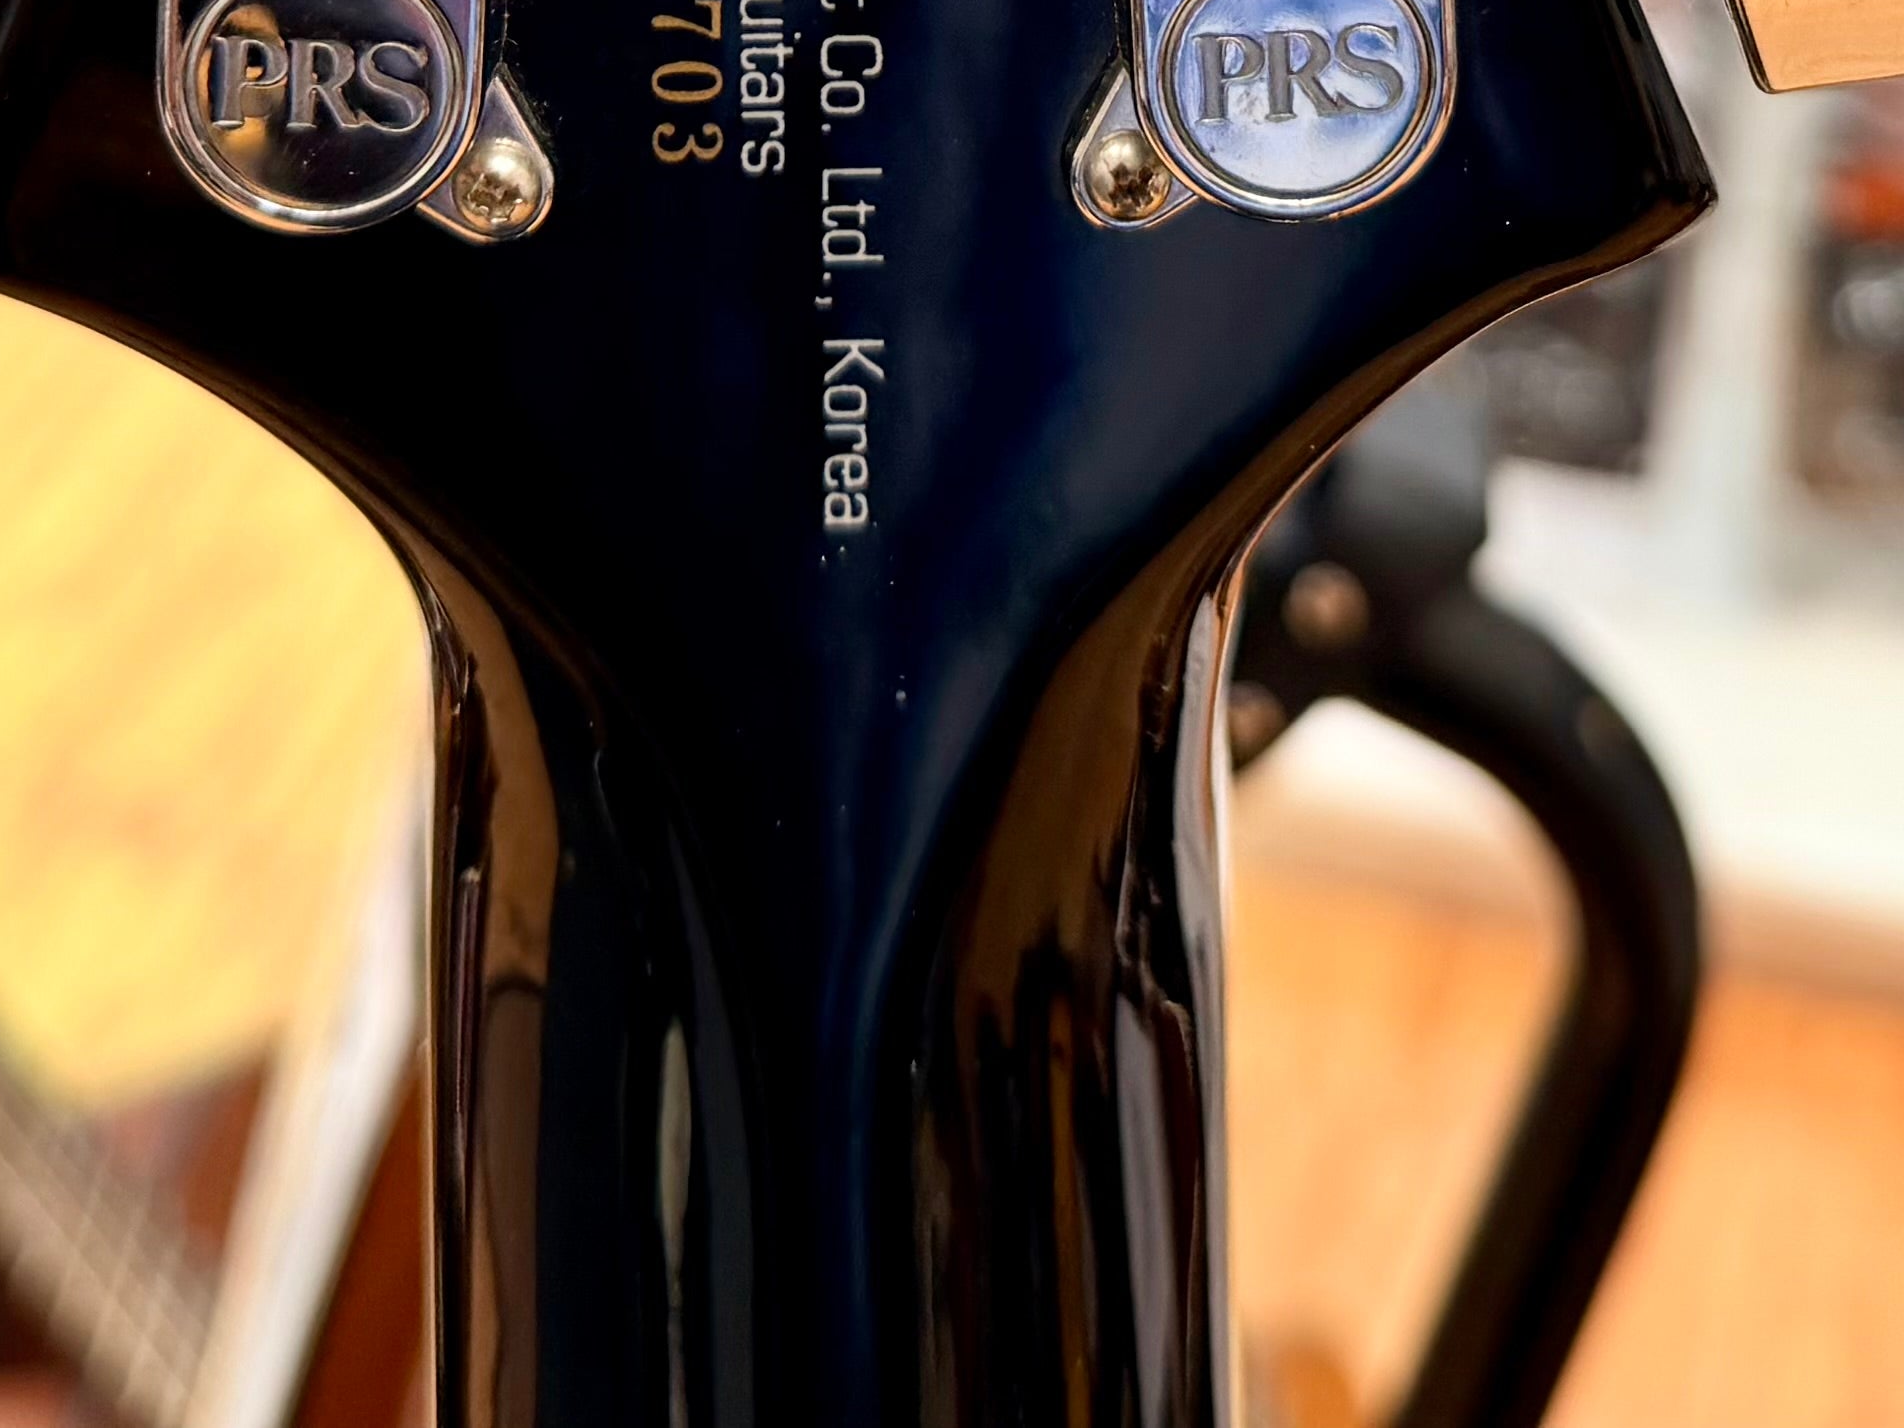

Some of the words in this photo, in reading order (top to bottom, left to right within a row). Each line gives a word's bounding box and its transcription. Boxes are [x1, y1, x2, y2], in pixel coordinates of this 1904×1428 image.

[210, 36, 431, 132] PRS
[820, 34, 884, 132] Co.
[1192, 22, 1405, 125] PRS
[815, 166, 885, 305] Ltd.,
[822, 338, 885, 527] Korea
